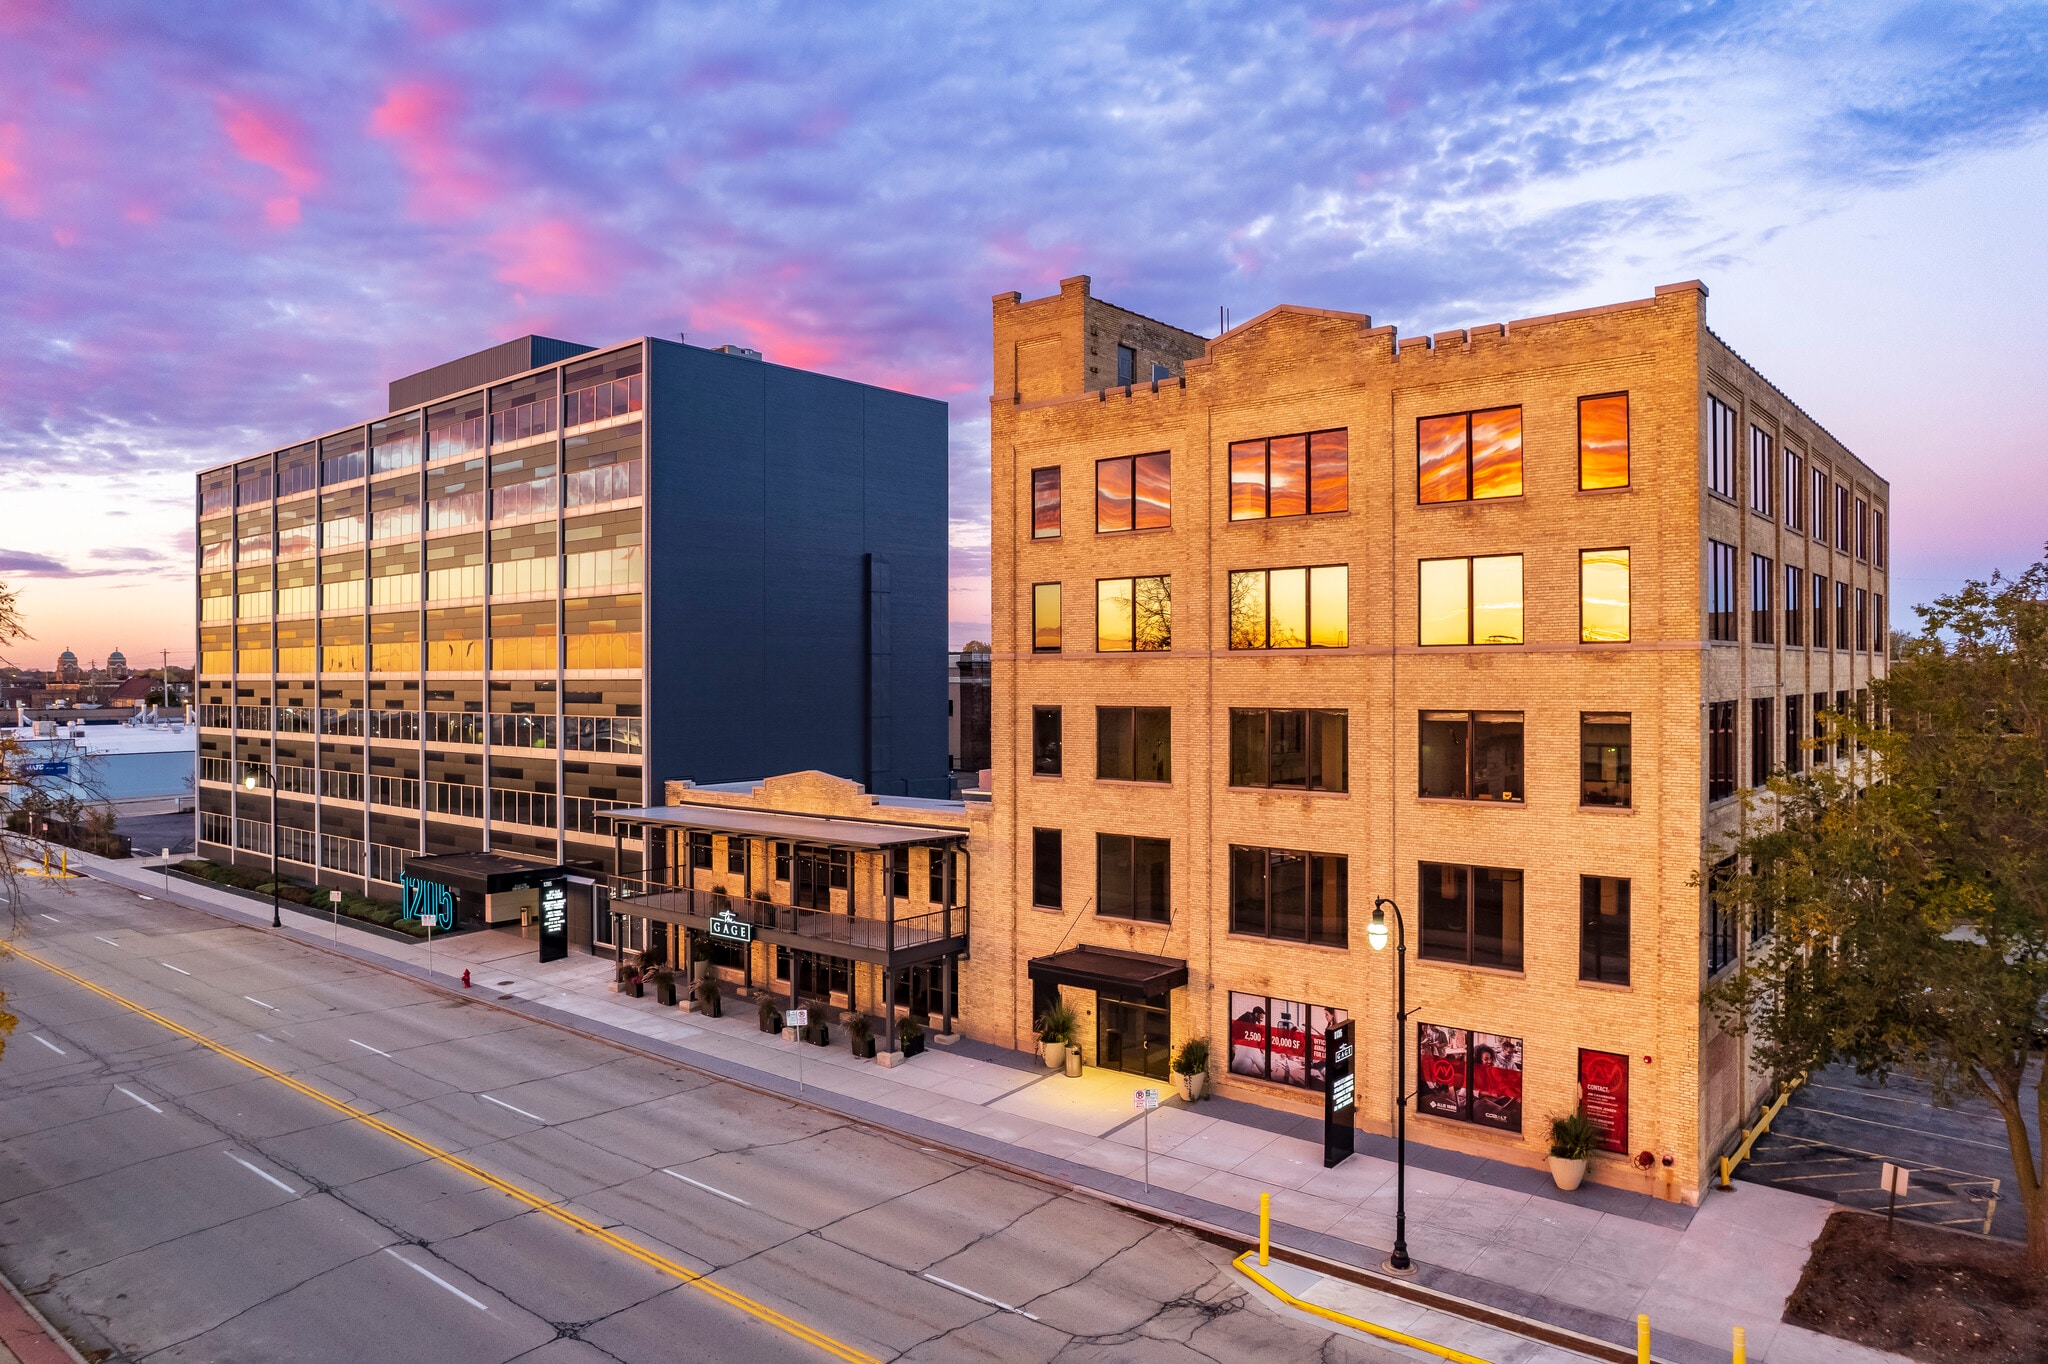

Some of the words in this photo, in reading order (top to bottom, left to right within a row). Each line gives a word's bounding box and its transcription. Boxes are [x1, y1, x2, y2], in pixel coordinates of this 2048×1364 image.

[400, 870, 452, 930] 1205
[713, 922, 746, 937] GAGE
[1244, 1031, 1261, 1041] 2,500
[1271, 1036, 1292, 1048] 20,000
[1292, 1040, 1301, 1049] SF
[1313, 1038, 1326, 1046] OFFIC
